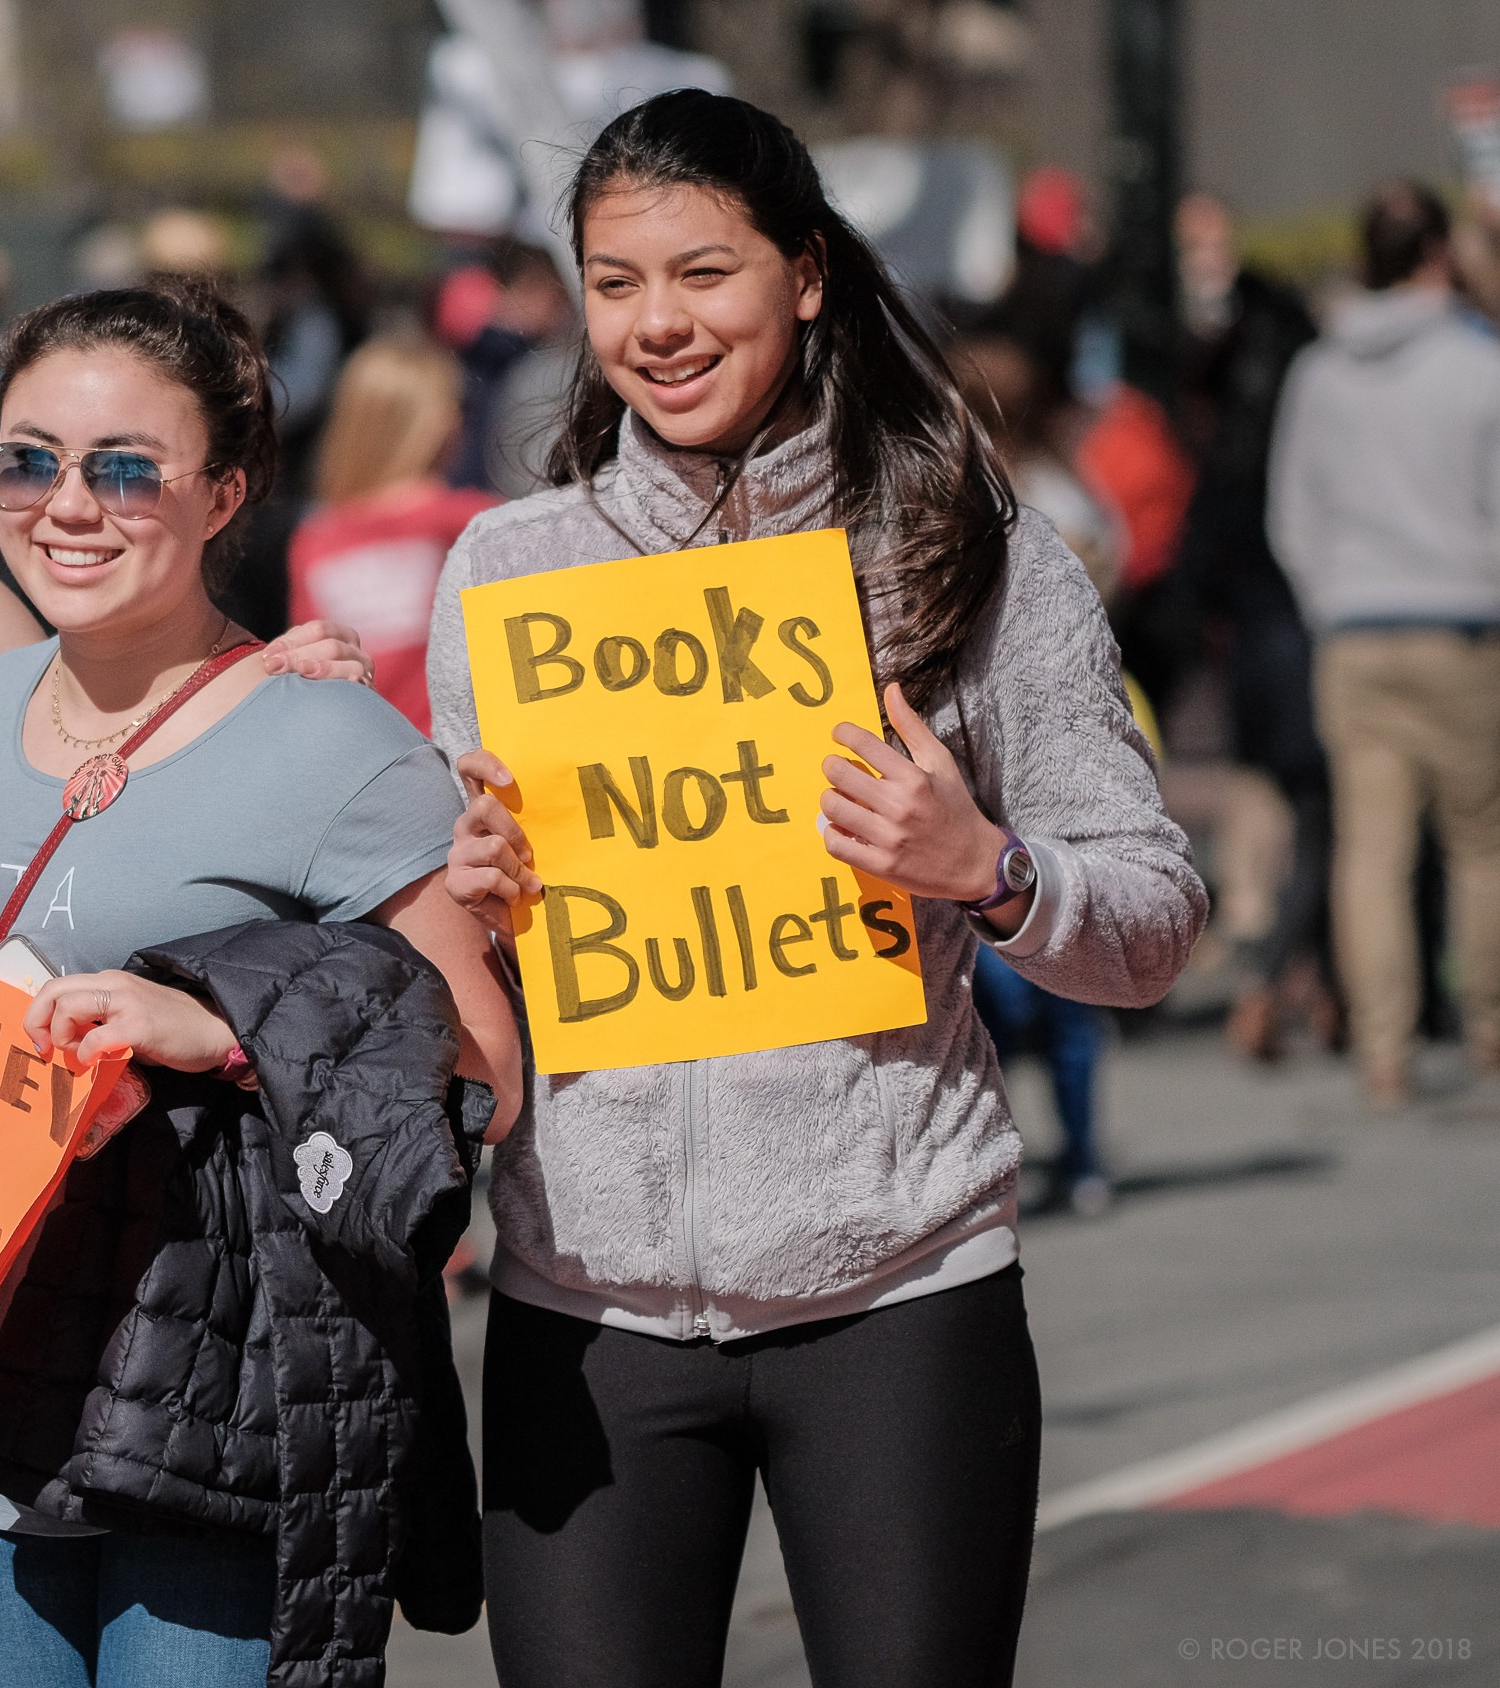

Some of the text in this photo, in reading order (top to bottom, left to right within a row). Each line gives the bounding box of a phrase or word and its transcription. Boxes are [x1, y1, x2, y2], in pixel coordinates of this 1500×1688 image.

[504, 586, 834, 708] Books
[577, 739, 791, 849] Not
[41, 866, 76, 930] A
[541, 876, 912, 1024] Bullets
[313, 1150, 334, 1199] salesforce
